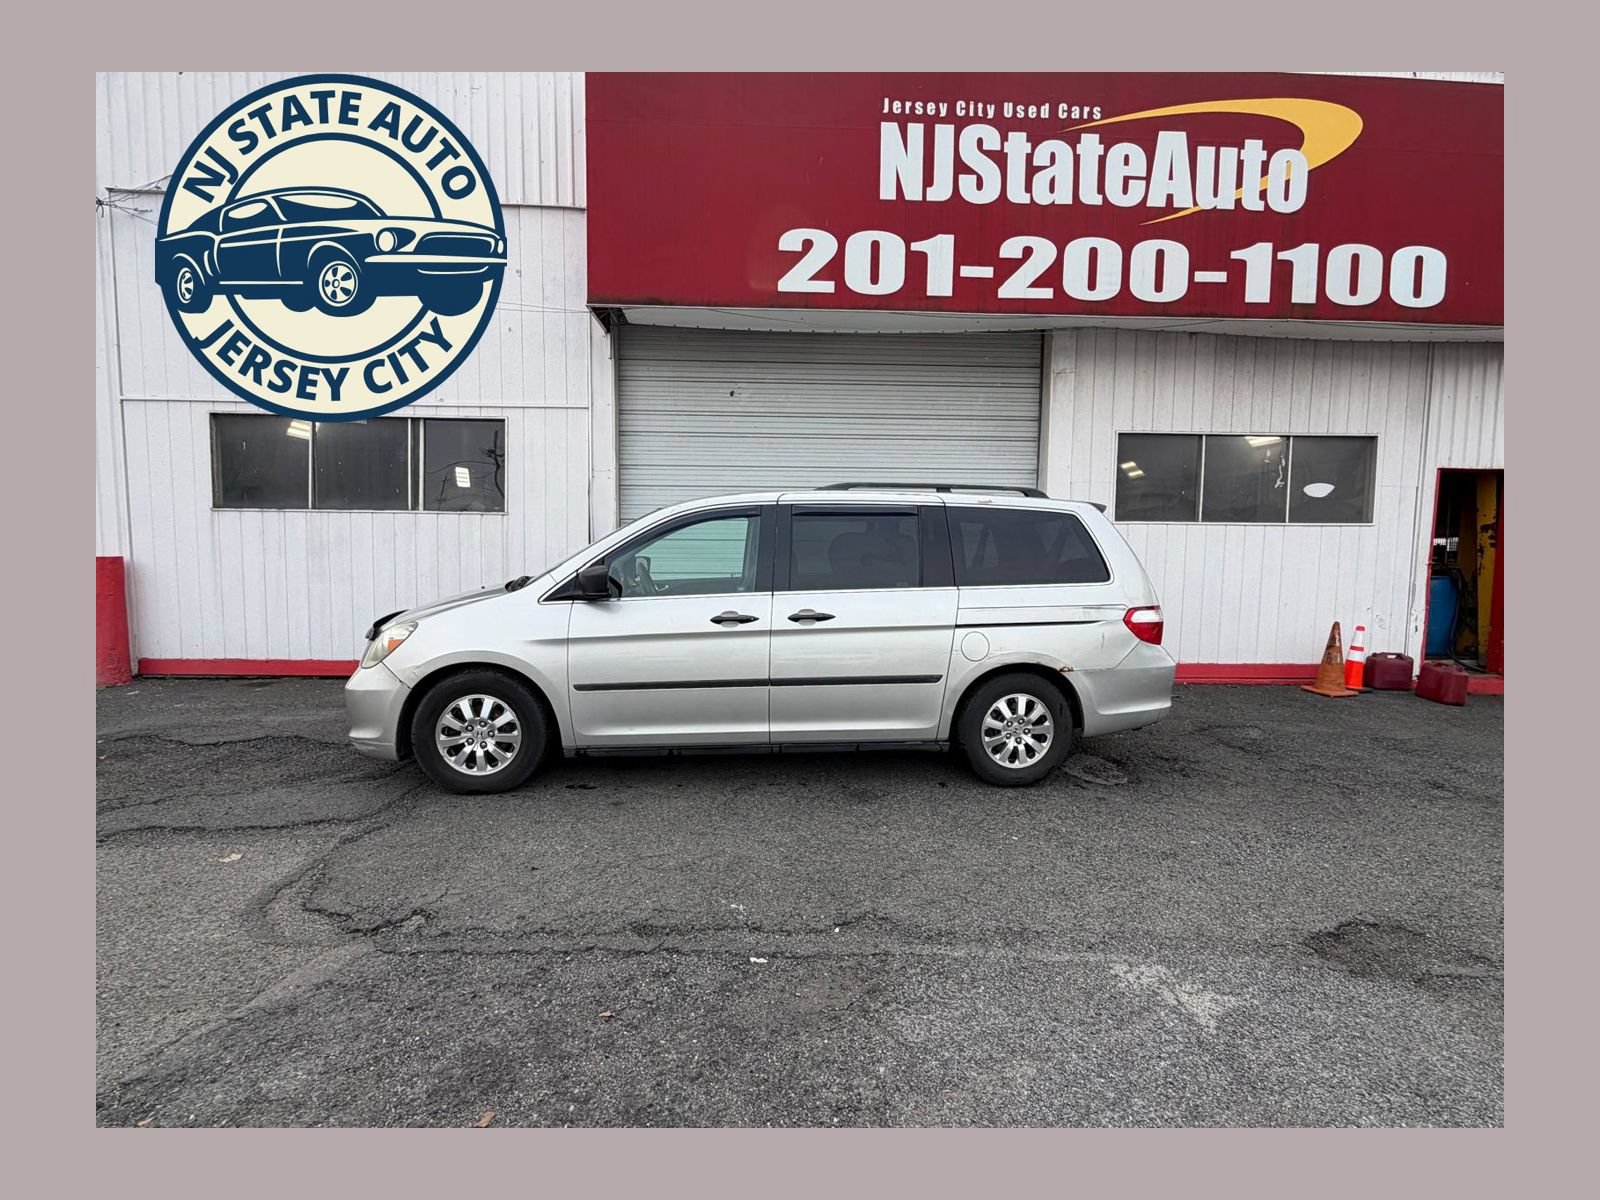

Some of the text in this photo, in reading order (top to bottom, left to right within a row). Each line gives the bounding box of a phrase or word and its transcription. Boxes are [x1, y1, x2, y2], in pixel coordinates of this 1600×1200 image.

[882, 97, 1102, 120] Jersey City Used Cars
[879, 121, 1308, 214] NJStateAuto
[777, 227, 1448, 308] 201-200-1100
